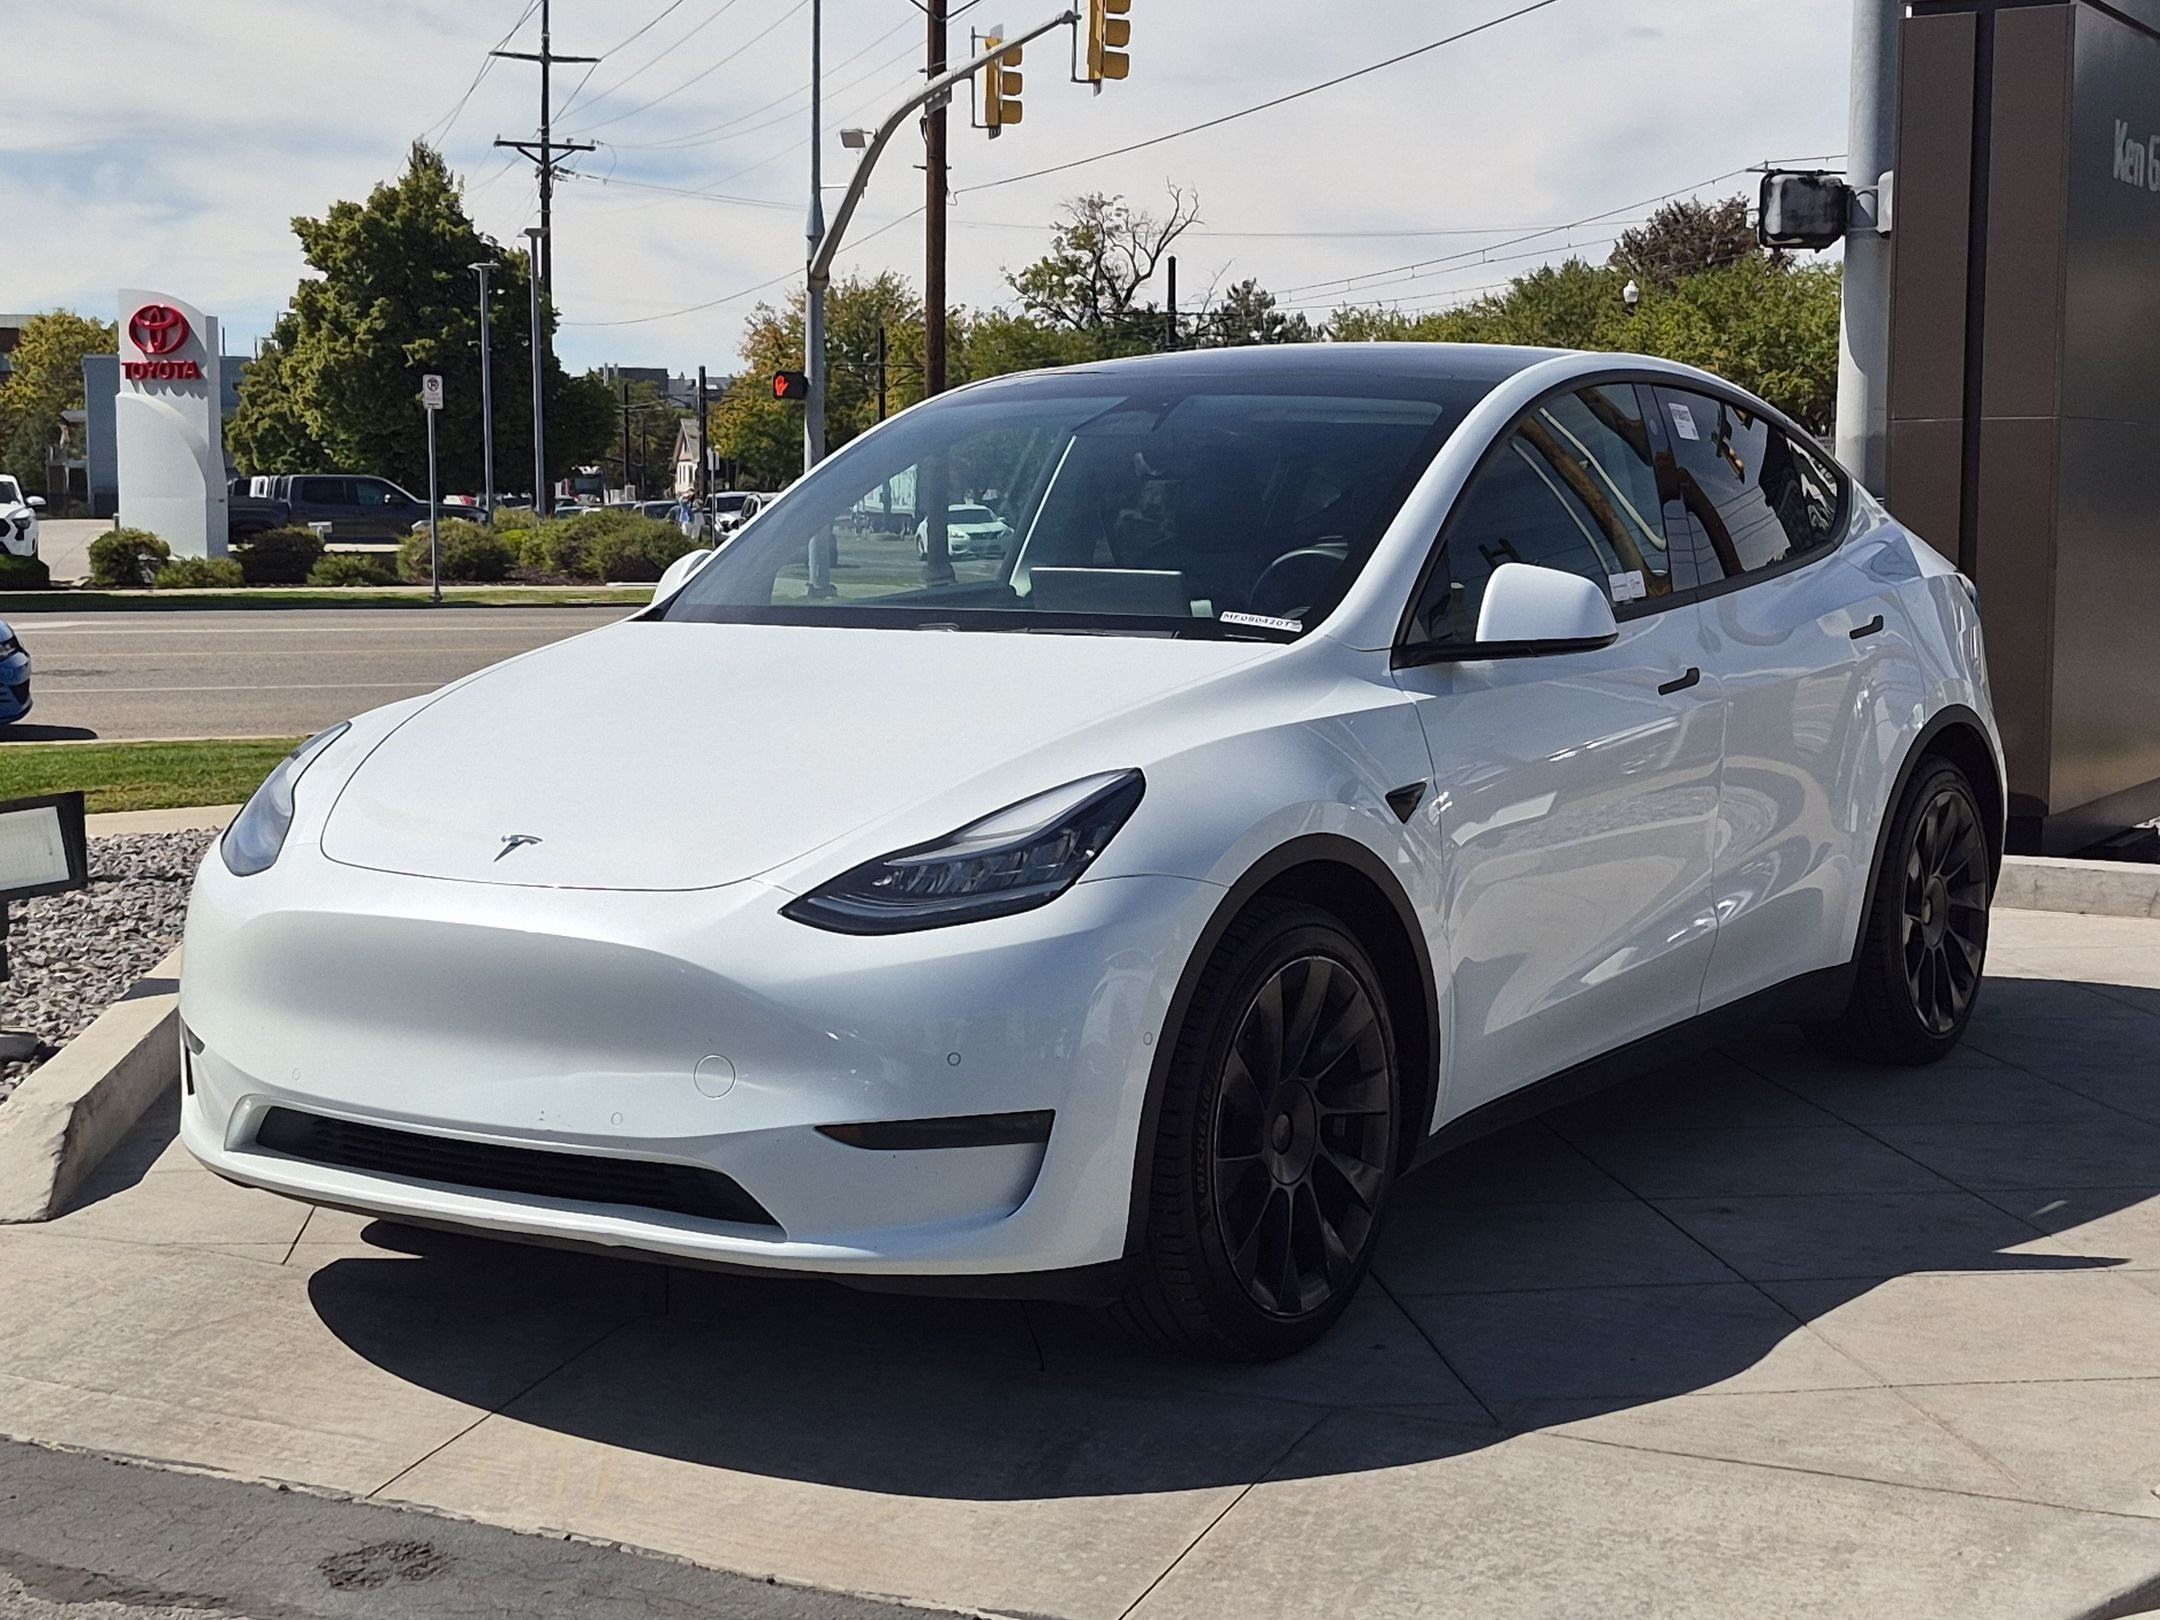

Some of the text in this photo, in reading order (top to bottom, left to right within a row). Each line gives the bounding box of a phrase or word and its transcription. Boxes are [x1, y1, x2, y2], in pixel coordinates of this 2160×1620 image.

[2113, 119, 2145, 188] Ken
[121, 361, 202, 380] TOYOTA
[1196, 1083, 1212, 1193] MICHELIN
